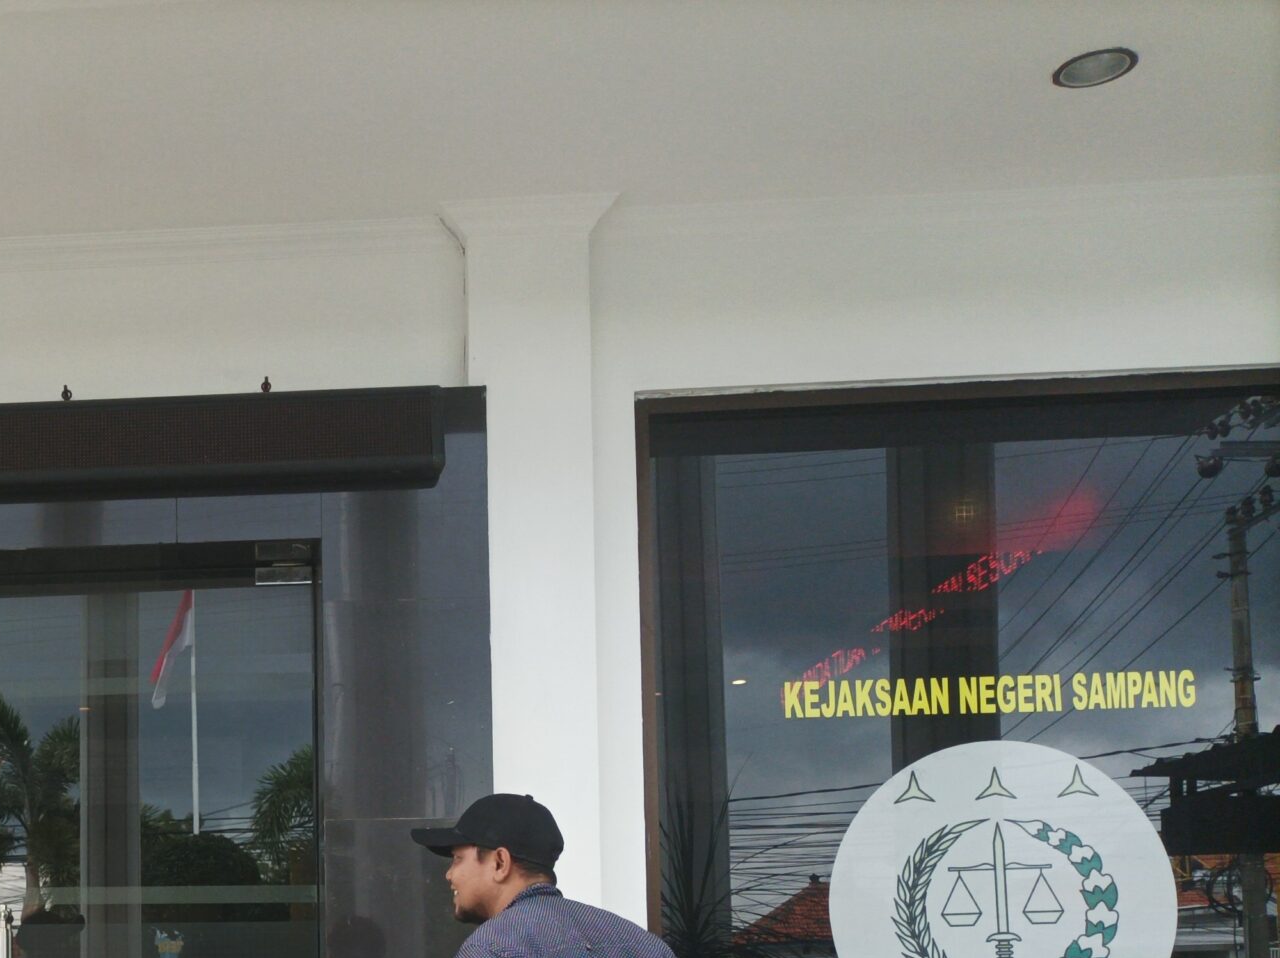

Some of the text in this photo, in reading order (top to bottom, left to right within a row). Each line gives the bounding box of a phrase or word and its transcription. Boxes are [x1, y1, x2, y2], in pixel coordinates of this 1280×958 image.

[783, 670, 1196, 718] KEJAKSAAN NEGERI SAMPANG
